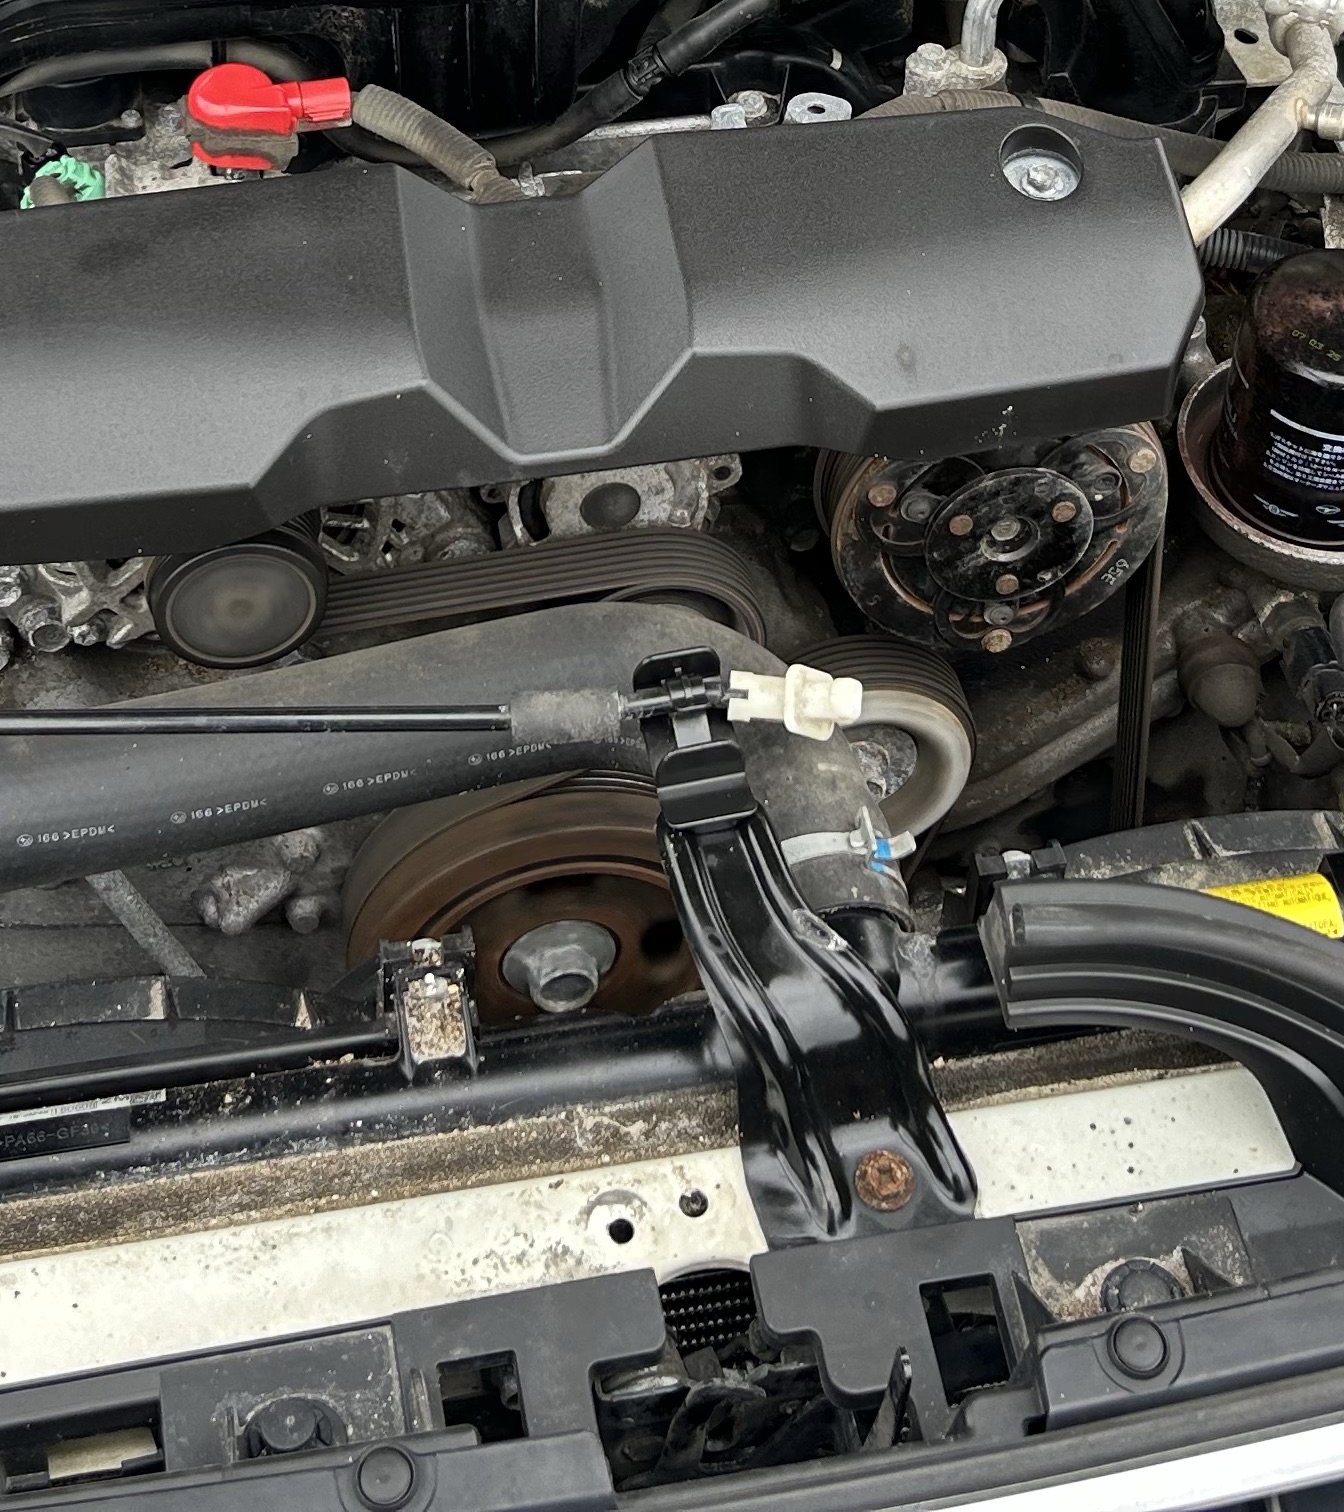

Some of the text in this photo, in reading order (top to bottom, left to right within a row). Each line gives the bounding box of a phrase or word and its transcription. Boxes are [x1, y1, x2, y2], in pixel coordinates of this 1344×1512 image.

[486, 749, 506, 763] 166
[341, 778, 365, 792] 166
[190, 807, 213, 821] 166
